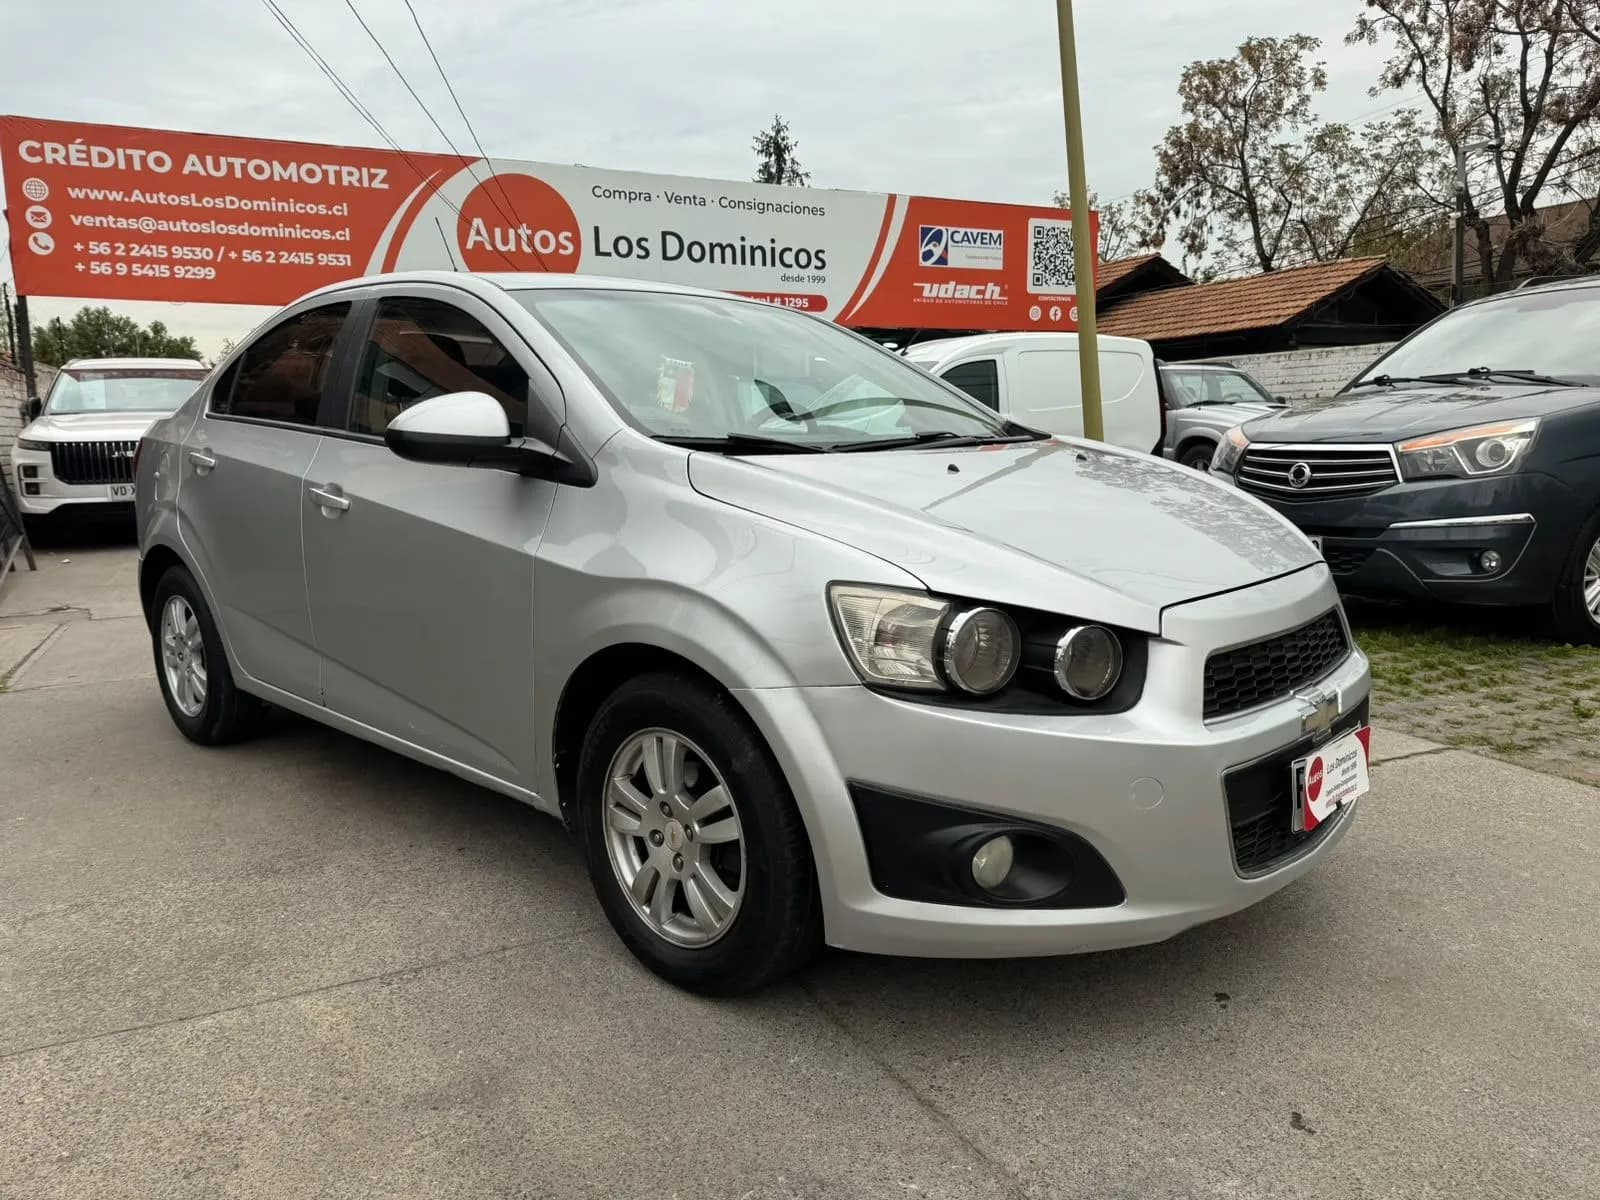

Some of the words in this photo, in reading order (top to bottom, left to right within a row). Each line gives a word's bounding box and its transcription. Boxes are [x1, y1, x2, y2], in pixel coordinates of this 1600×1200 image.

[18, 138, 173, 174] CRÉDITO
[182, 153, 390, 190] AUTOMOTRIZ
[67, 186, 348, 216] www.AutosLosDominicos.cl
[591, 185, 652, 204] Compra
[664, 191, 707, 207] Venta
[718, 196, 826, 217] Consignaciones
[70, 213, 350, 241] ventas@autoslosdominicos.cl
[465, 217, 574, 256] Autos
[950, 230, 1002, 246] CAVEM
[88, 241, 111, 255] 56
[114, 243, 127, 256] 2
[129, 243, 168, 258] 2415
[171, 245, 214, 260] 9530
[241, 250, 263, 263] 56
[265, 251, 276, 264] 2
[279, 251, 314, 266] 2415
[318, 253, 351, 267] 9531
[593, 225, 650, 260] Los
[660, 230, 827, 271] Dominicos
[89, 261, 112, 275] 56
[115, 263, 128, 276] 9
[131, 263, 170, 278] 5415
[173, 265, 216, 280] 9299
[780, 273, 805, 283] desde
[806, 275, 826, 284] 1999
[784, 297, 809, 308] 1295
